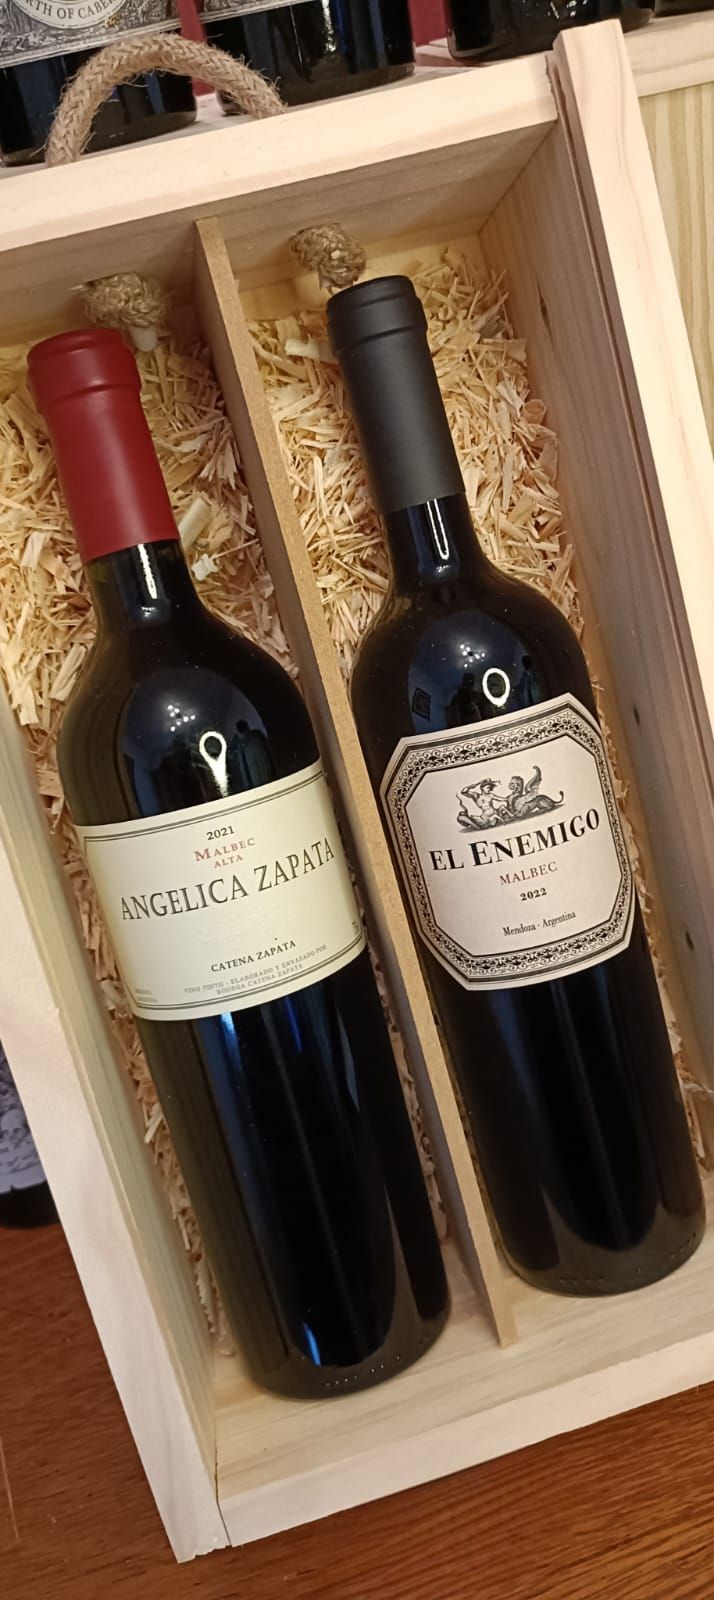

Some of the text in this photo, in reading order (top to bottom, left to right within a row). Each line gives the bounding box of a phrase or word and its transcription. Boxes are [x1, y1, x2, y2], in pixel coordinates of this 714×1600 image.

[56, 8, 75, 20] OF
[206, 825, 235, 841] 2021
[429, 808, 600, 871] EL ENEMIGO
[194, 837, 256, 862] MALBEC
[213, 854, 244, 868] ALTA
[121, 836, 335, 920] ANGELICA ZAPATA
[500, 861, 558, 885] MALBEC
[520, 887, 547, 901] 2022
[502, 921, 536, 937] Mendoza
[542, 910, 577, 928] Argentina
[210, 940, 297, 972] CATENA ZAPATA
[247, 974, 277, 987] CATENA
[278, 964, 304, 978] ZAPATA
